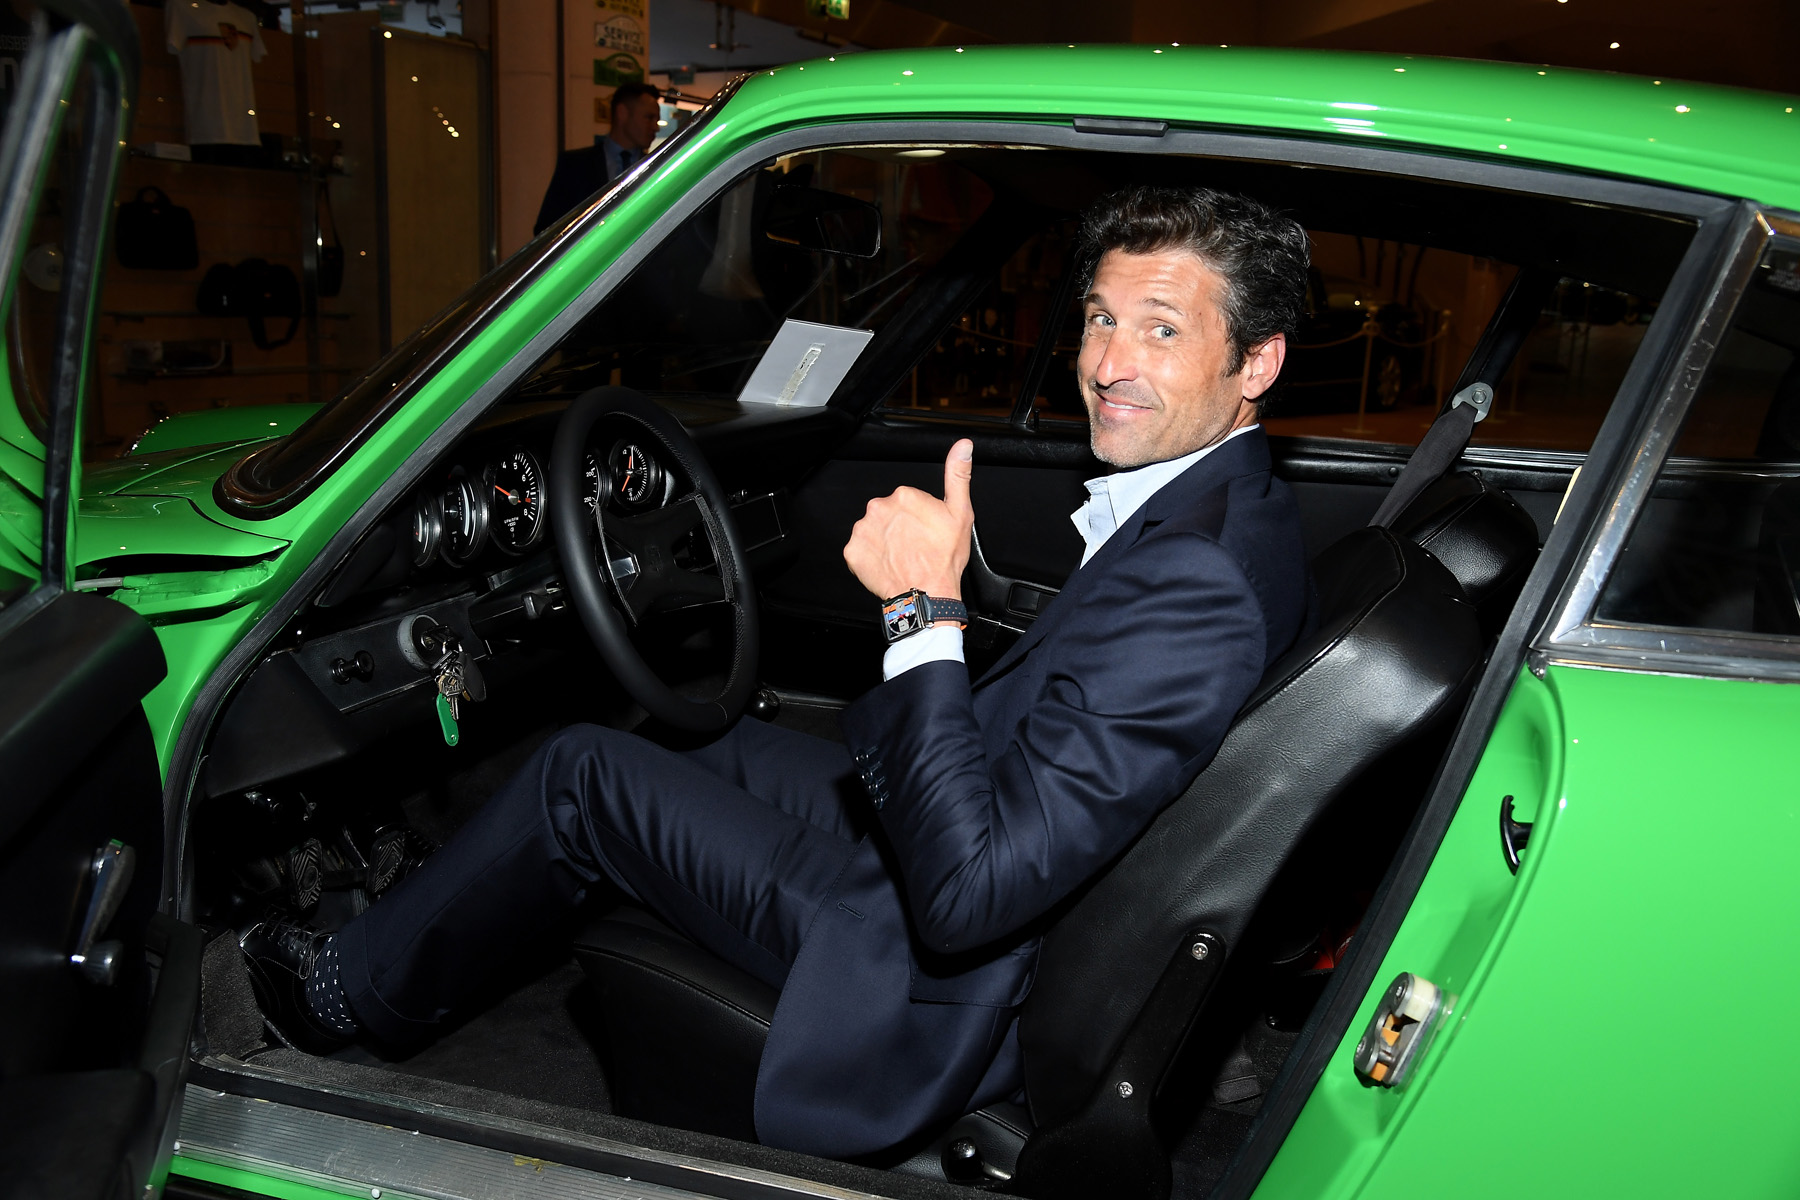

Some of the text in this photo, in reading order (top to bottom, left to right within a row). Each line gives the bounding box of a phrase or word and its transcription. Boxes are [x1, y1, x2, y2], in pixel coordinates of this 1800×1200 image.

[513, 462, 518, 470] 5
[521, 474, 527, 482] 6
[525, 490, 530, 498] 7
[523, 508, 528, 516] 8
